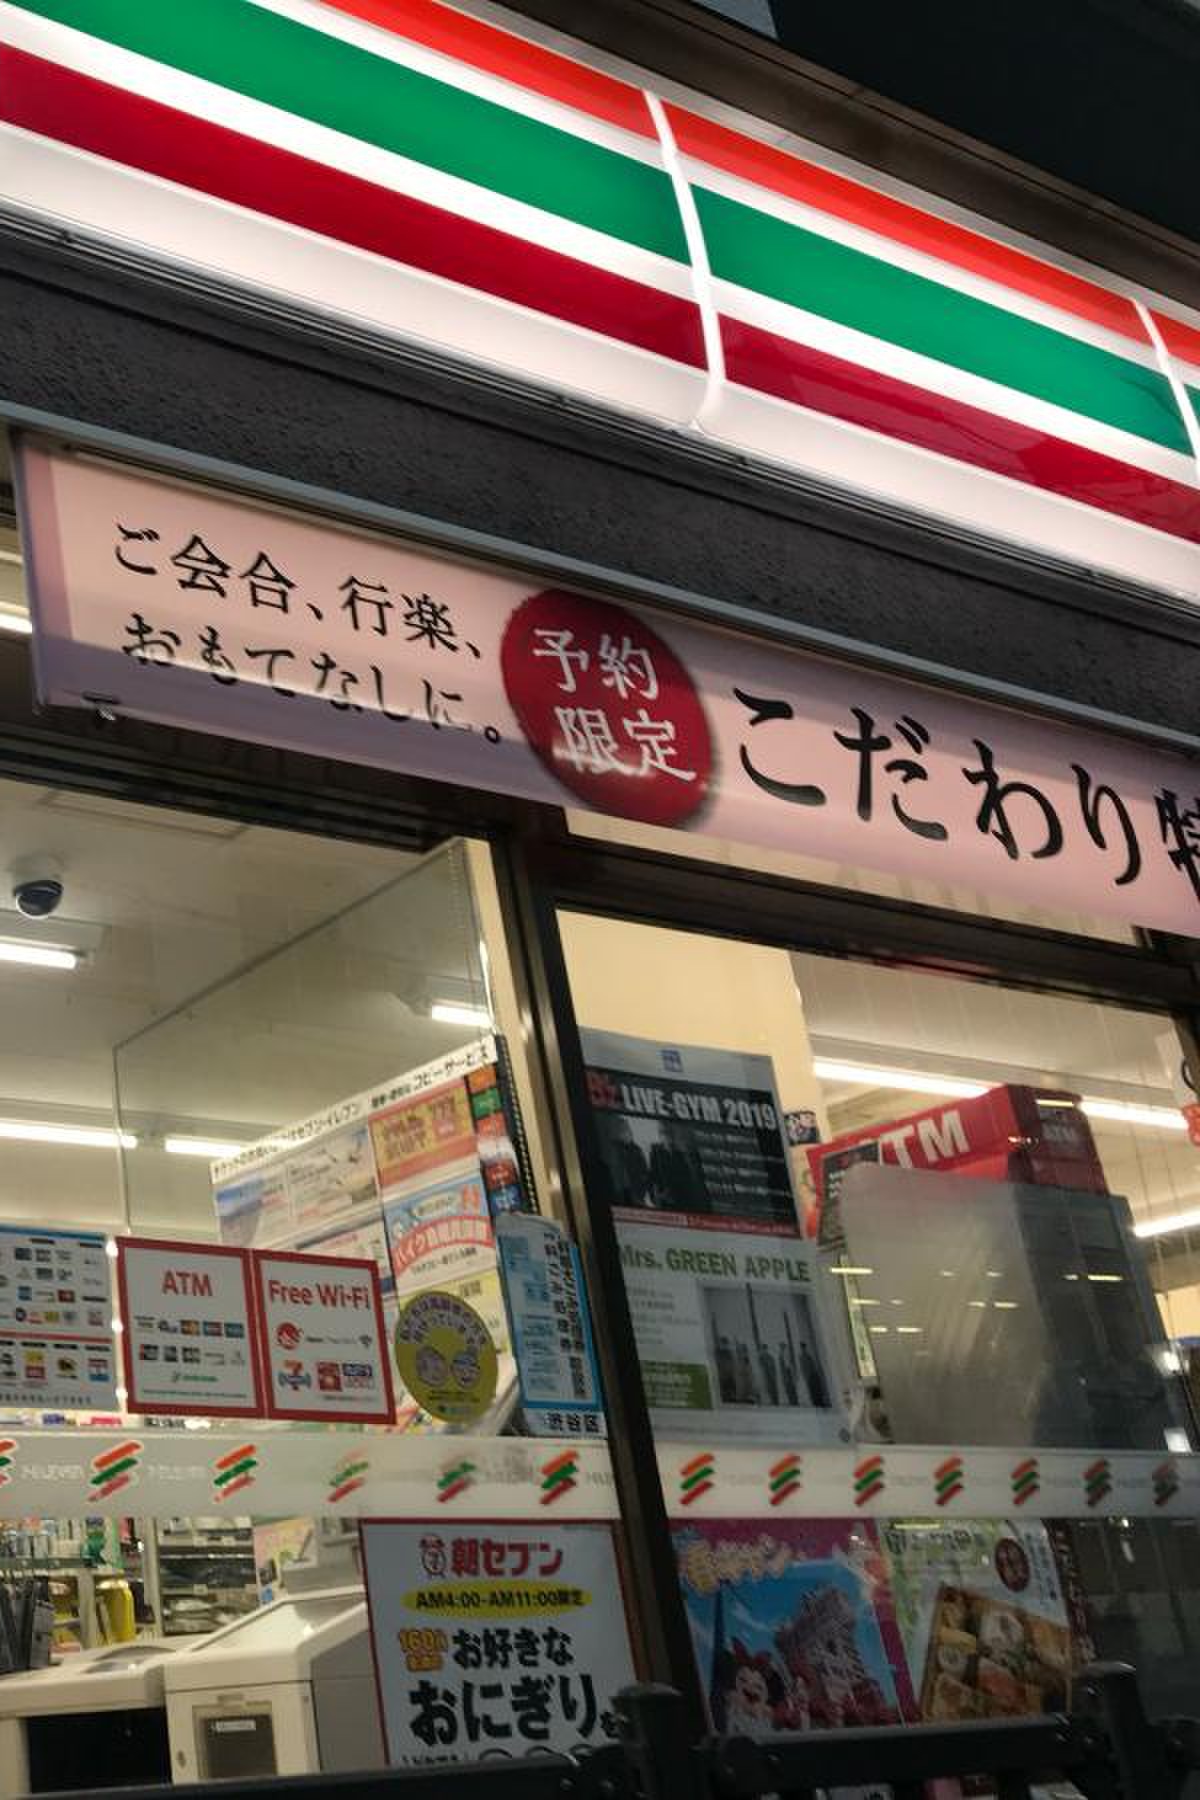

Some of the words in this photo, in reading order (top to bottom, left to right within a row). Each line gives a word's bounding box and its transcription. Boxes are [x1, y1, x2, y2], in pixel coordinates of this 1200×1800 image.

[114, 522, 482, 659] ご会合、行楽、
[121, 613, 501, 744] おもてなしに。
[533, 628, 659, 701] 予約
[553, 705, 696, 783] 限定
[723, 1099, 778, 1130] 2019
[161, 1270, 213, 1297] ATM
[666, 1246, 737, 1277] GREEN
[745, 1254, 811, 1282] APPLE
[268, 1279, 312, 1306] Free
[316, 1284, 370, 1309] Wi-Fi
[452, 1538, 562, 1576] 朝セブン
[452, 1626, 574, 1670] お好きな
